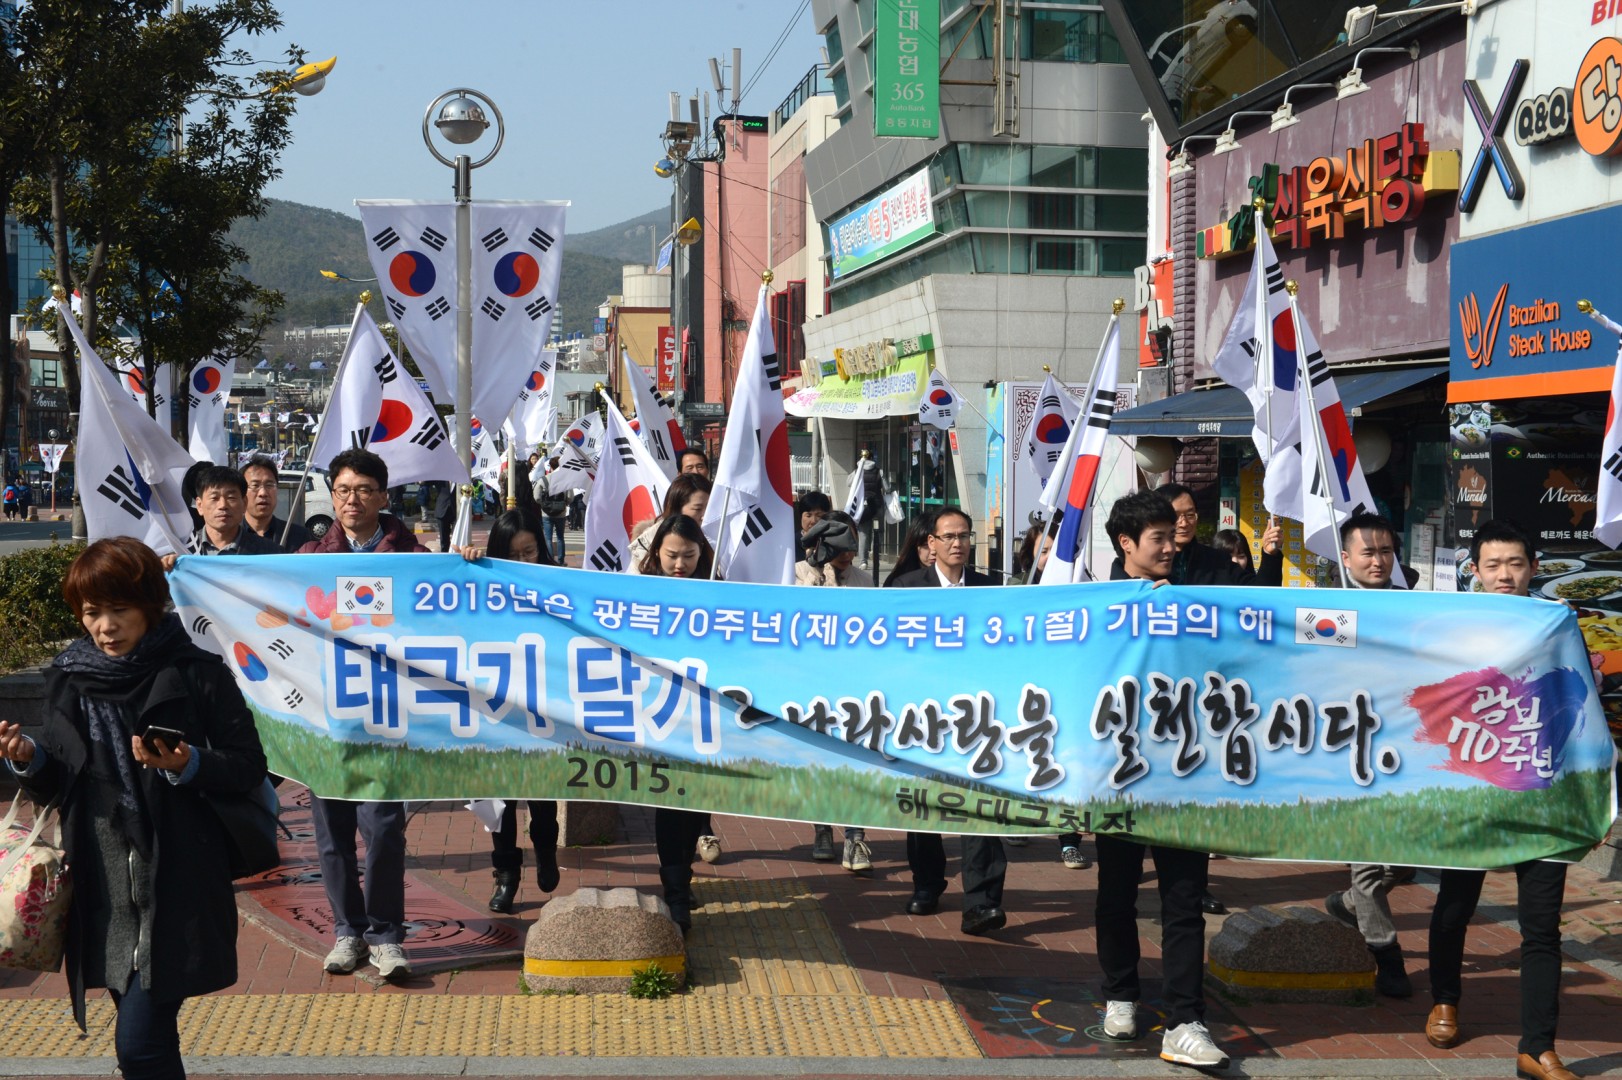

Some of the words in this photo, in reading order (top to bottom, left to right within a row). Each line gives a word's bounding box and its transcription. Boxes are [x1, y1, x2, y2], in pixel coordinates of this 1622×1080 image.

[890, 103, 908, 112] Auto
[908, 104, 925, 112] Bank
[891, 82, 925, 102] 365
[1518, 94, 1566, 140] Q&Q
[1508, 298, 1560, 328] Brazilian
[1508, 330, 1545, 358] Steak
[1549, 328, 1592, 352] House
[1456, 484, 1488, 504] Mercado
[1540, 530, 1571, 540] 메르까도
[414, 582, 574, 620] 2015년은
[983, 610, 1089, 645] 3.1절)
[1107, 602, 1219, 639] 기념의
[1238, 607, 1273, 641] 해
[333, 637, 547, 729] 태극기
[1094, 671, 1396, 785] 실천합시다.
[1470, 685, 1544, 747] 광복
[1447, 715, 1555, 779] 70주년
[565, 757, 687, 797] 2015.
